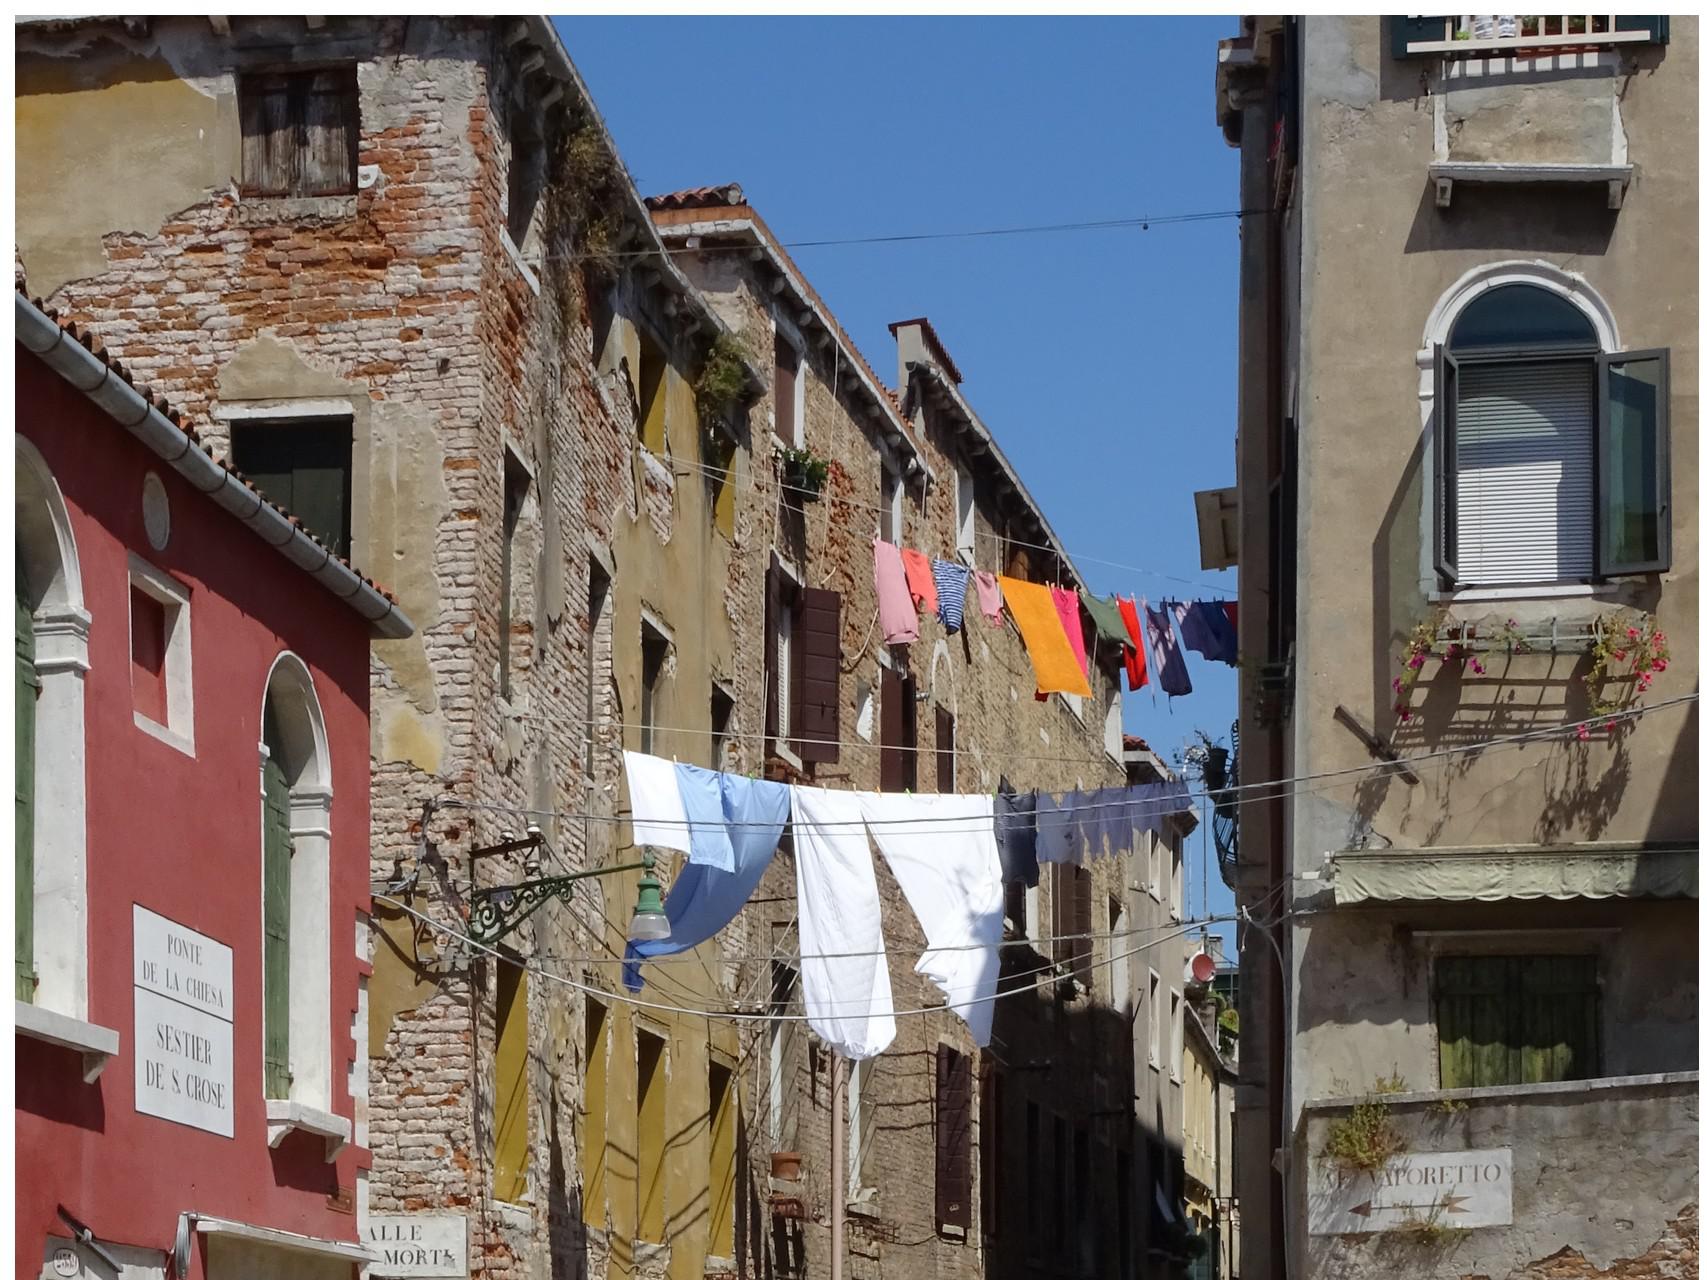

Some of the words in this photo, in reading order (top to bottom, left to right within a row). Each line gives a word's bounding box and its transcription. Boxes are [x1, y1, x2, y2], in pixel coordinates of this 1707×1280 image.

[167, 933, 203, 967] PONTE
[143, 959, 158, 984] DE
[166, 967, 180, 992] LA
[186, 976, 224, 1009] CHIESA
[156, 1022, 212, 1066] SESTIER
[146, 1059, 165, 1091] DE
[186, 1073, 225, 1110] CROSE
[369, 1224, 423, 1241] ALLE
